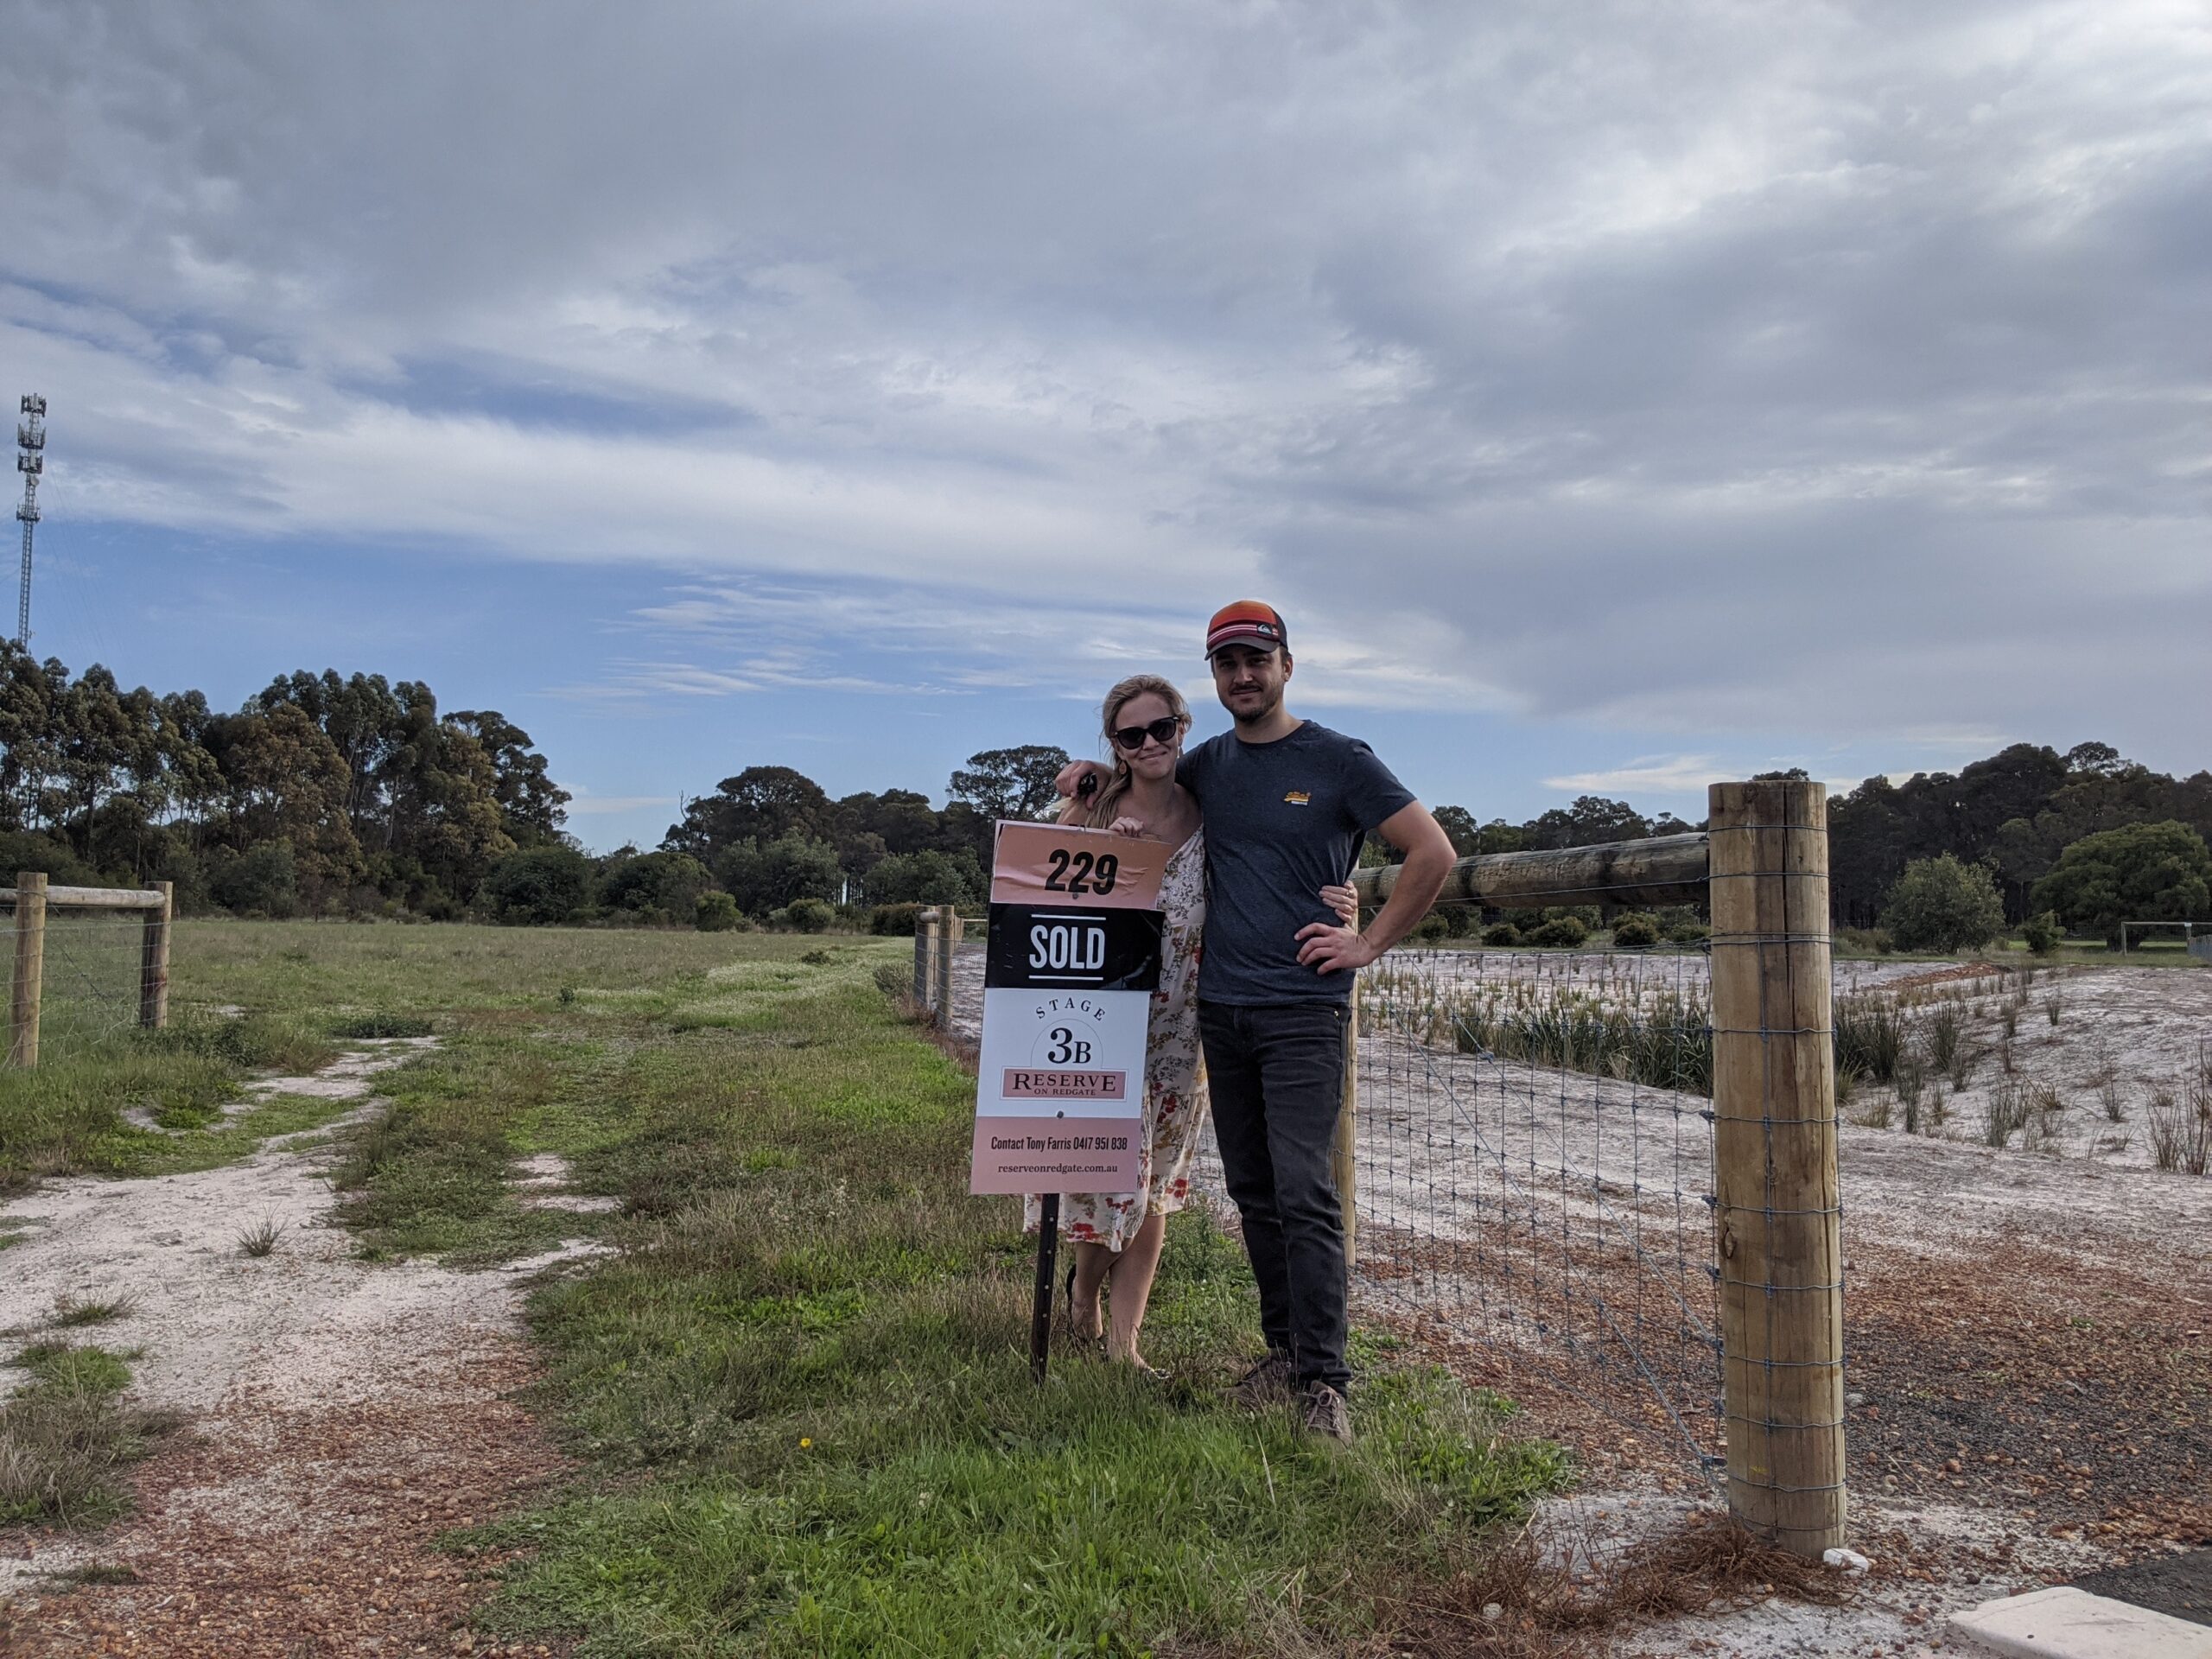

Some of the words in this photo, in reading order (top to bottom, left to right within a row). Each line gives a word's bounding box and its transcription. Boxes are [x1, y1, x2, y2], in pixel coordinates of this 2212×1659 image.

[1045, 849, 1118, 895] 229
[1029, 925, 1105, 969] SOLD
[1035, 997, 1106, 1021] STAGE
[1047, 1027, 1091, 1064] 3B
[1012, 1073, 1116, 1091] RESERVE
[991, 1136, 1025, 1150] Contact
[1027, 1136, 1046, 1153] Tony
[1047, 1136, 1071, 1150] Farris
[1073, 1137, 1093, 1150] 0417
[1095, 1137, 1109, 1150] 951
[1111, 1137, 1128, 1150] 838
[998, 1163, 1118, 1174] reserveonredgate.com.au
